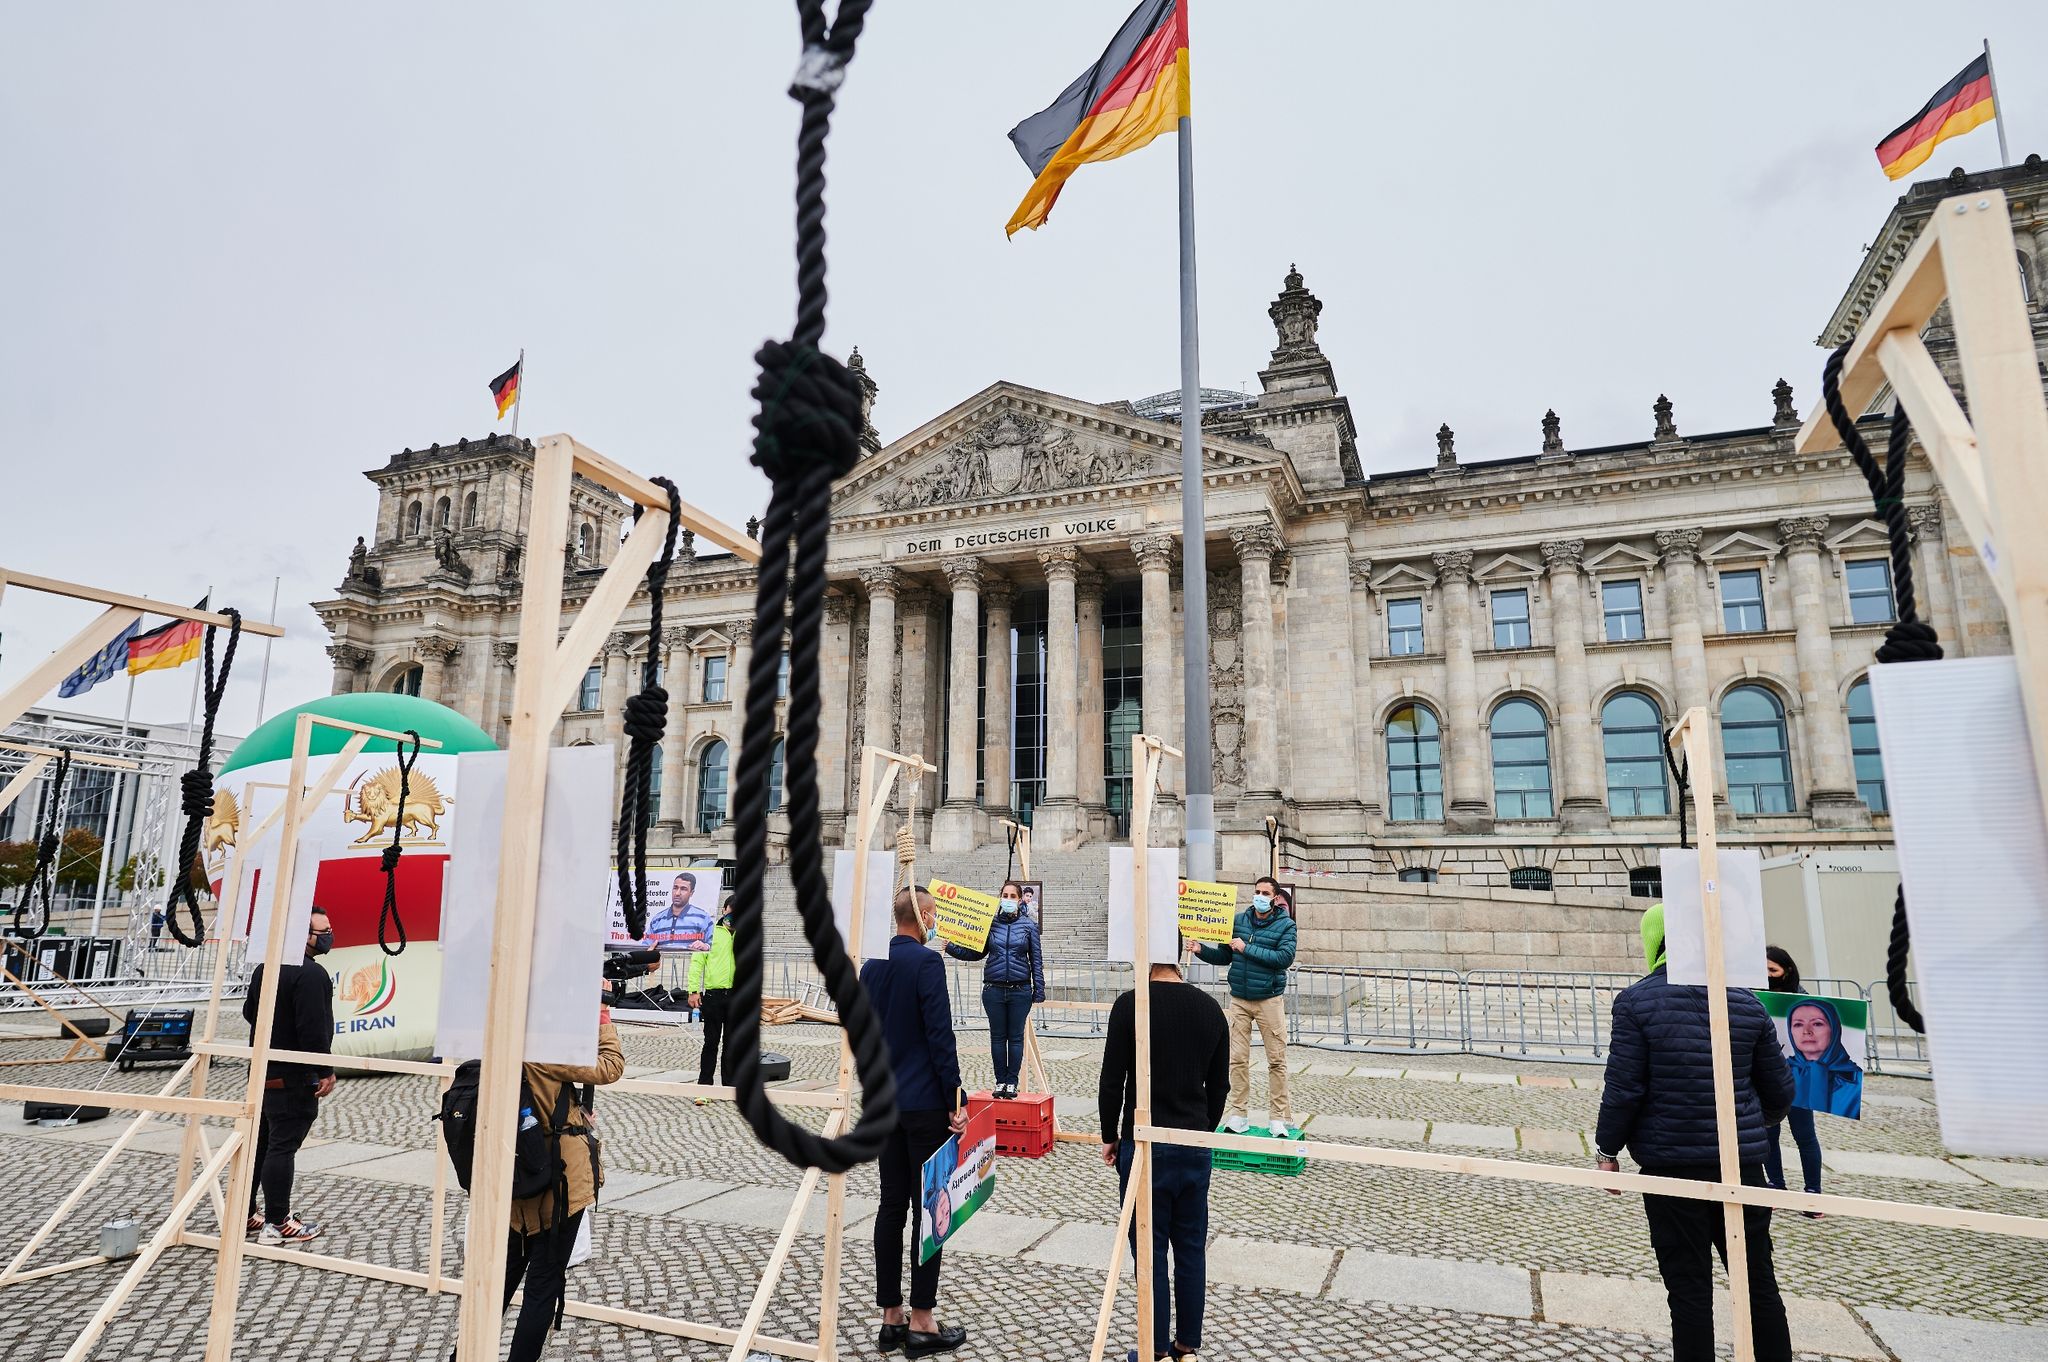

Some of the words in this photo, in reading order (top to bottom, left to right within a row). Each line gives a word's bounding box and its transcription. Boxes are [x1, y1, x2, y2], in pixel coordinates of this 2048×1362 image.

[907, 538, 941, 553] DEM
[955, 526, 1050, 548] DEUTSCHEN
[1065, 518, 1117, 535] VOLKE
[937, 884, 957, 899] 40
[1188, 888, 1222, 897] Dissidenten
[612, 920, 624, 928] the
[934, 912, 956, 925] aryam
[957, 918, 985, 933] Rajavi:
[1196, 913, 1228, 925] Rajavi:
[611, 931, 625, 940] The
[938, 924, 967, 938] Executions
[974, 936, 984, 945] Iran
[1217, 928, 1231, 936] Iran
[351, 1016, 396, 1033] IRAN
[951, 1164, 976, 1191] penalty
[965, 1190, 972, 1200] to
